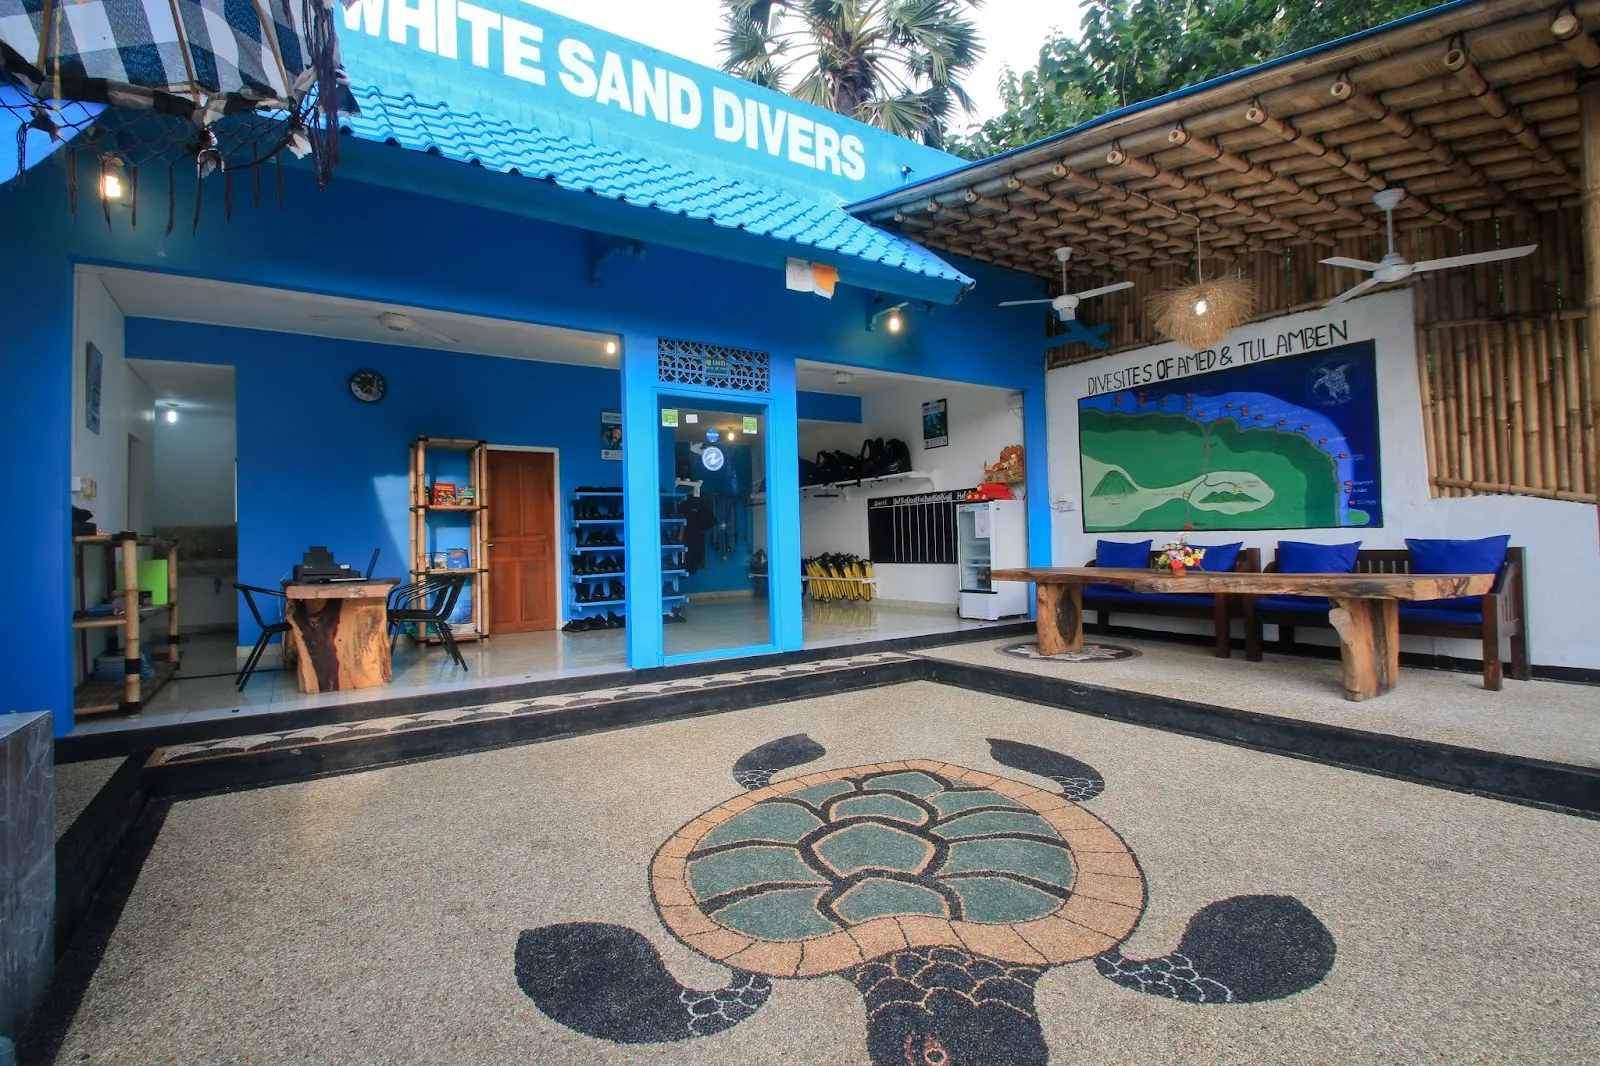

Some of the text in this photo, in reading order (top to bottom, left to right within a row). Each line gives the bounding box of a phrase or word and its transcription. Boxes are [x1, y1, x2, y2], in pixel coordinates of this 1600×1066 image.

[557, 38, 703, 131] SAND
[713, 86, 866, 181] DIVERS
[1087, 319, 1348, 395] DIVESITES OF AMED & TULAMBEN
